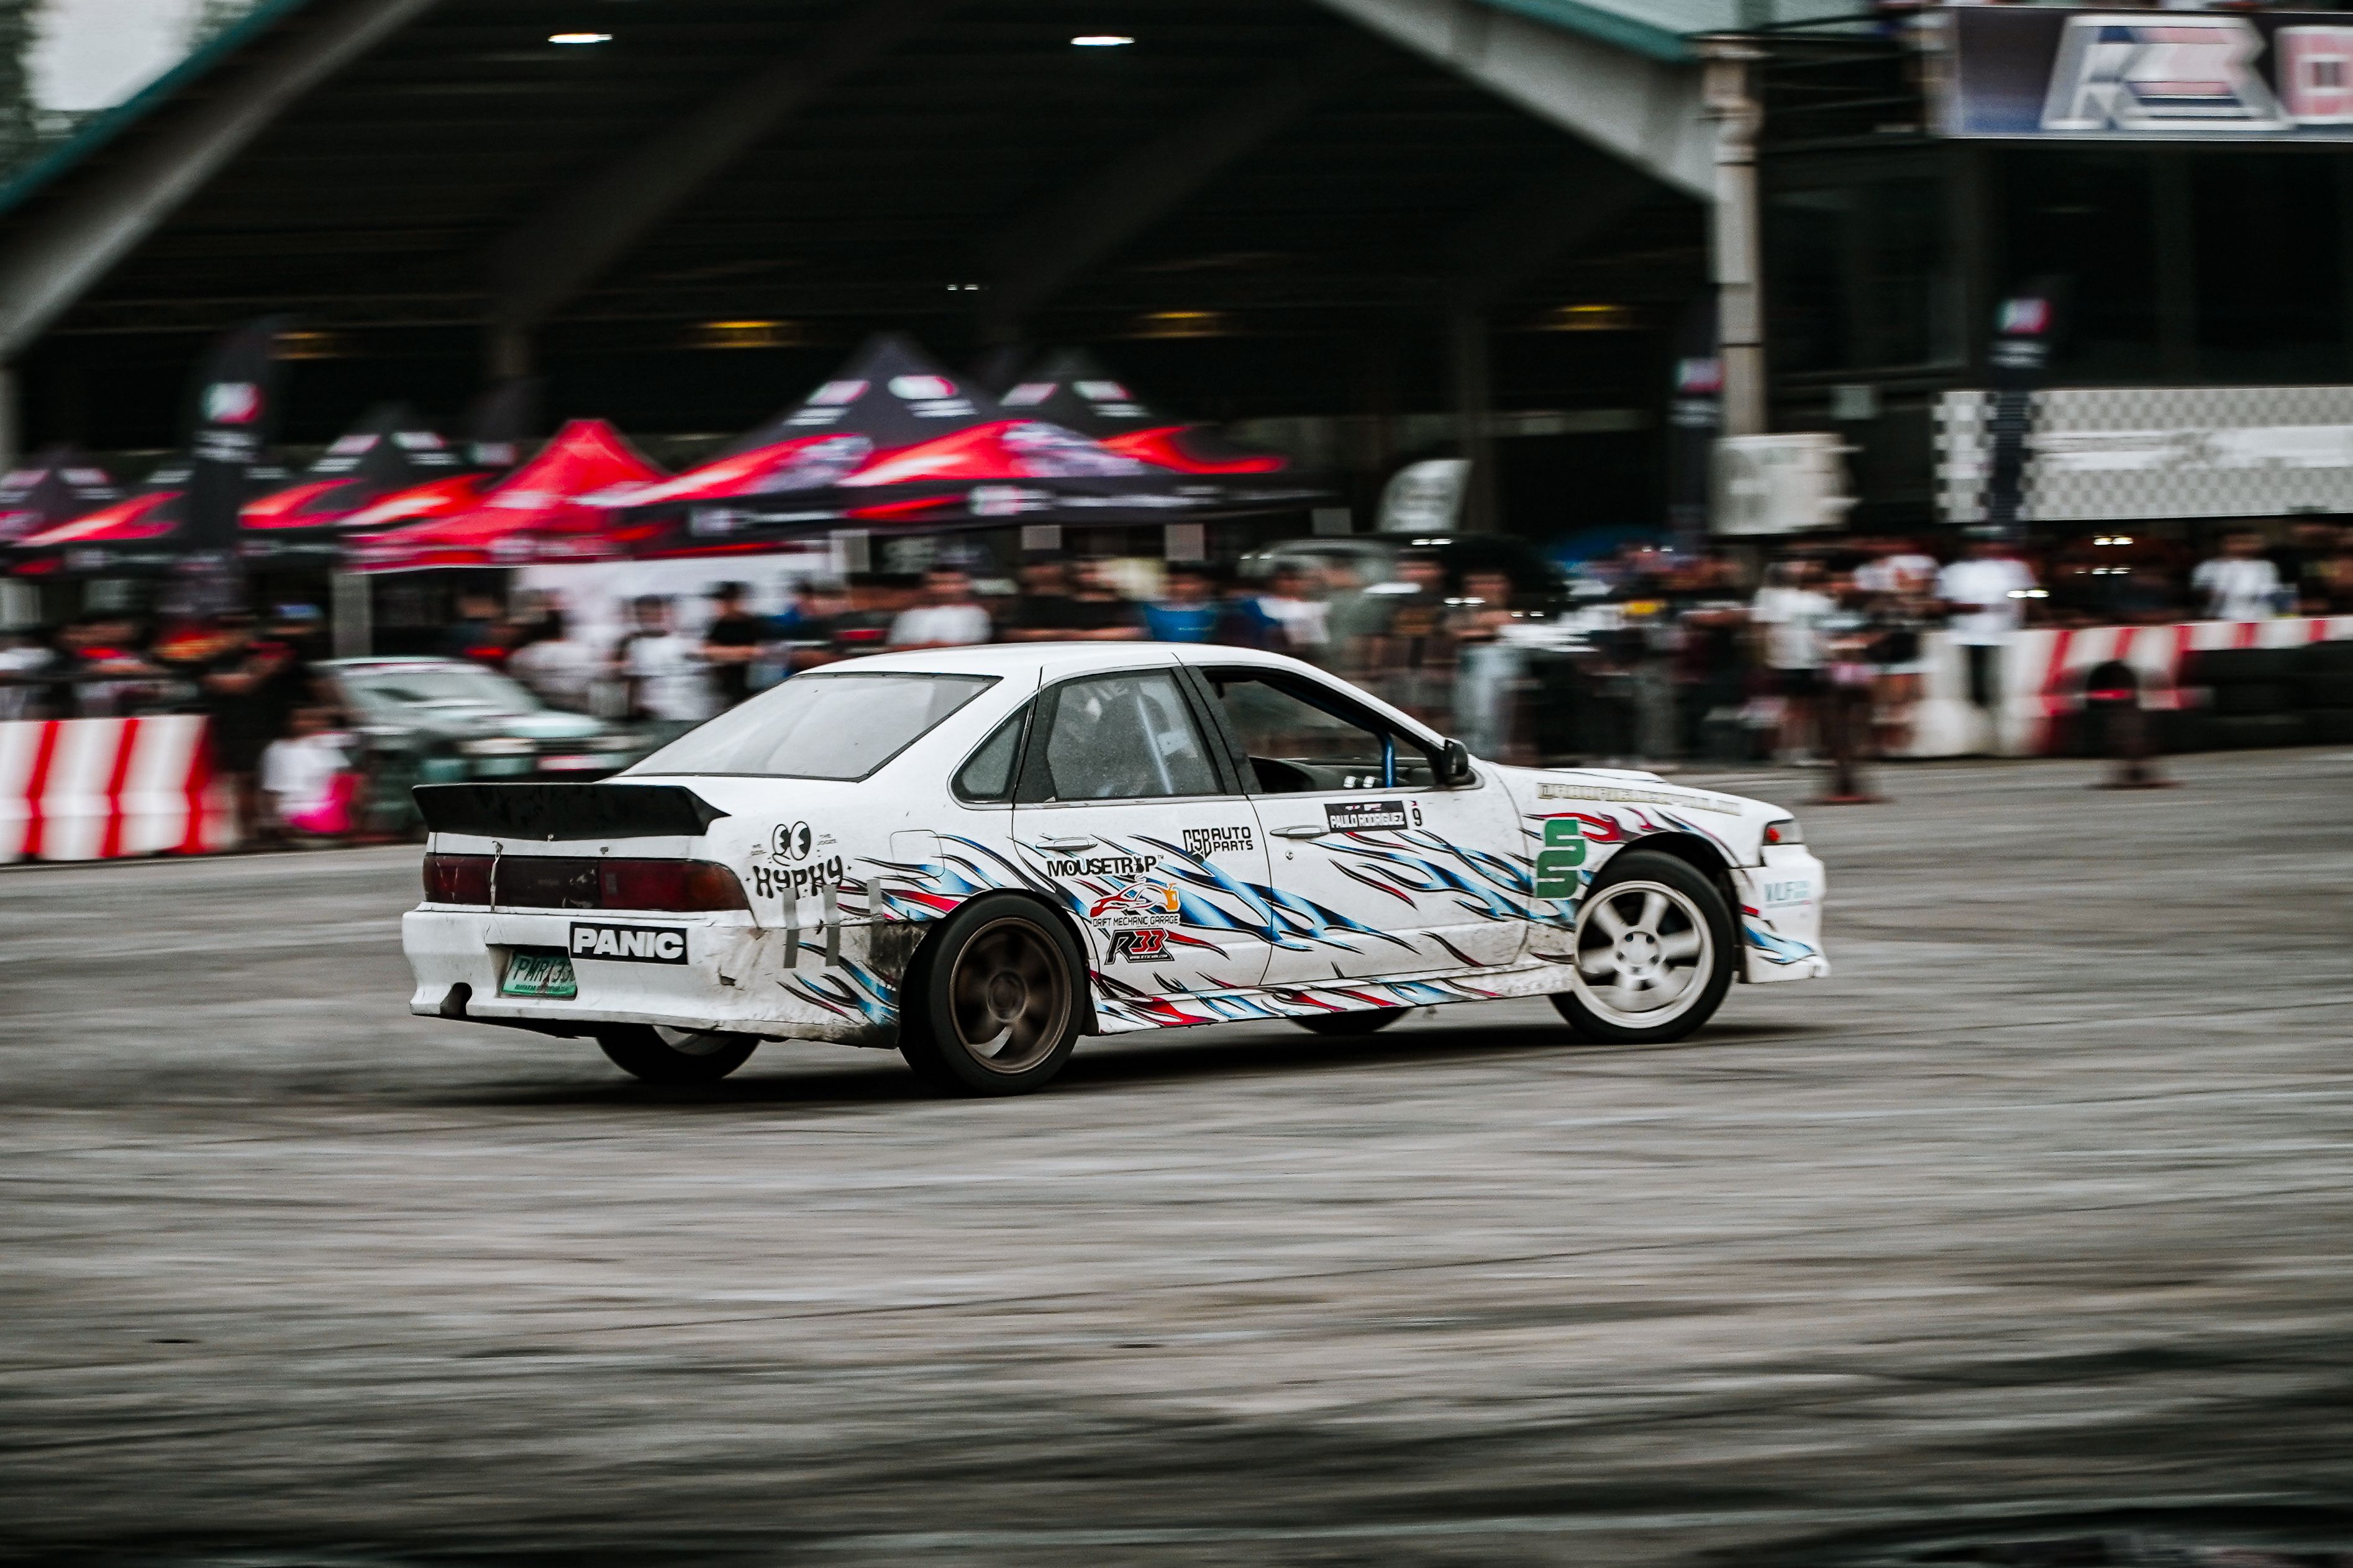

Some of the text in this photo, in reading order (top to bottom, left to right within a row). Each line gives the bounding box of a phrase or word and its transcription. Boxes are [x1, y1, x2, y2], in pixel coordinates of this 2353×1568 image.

[1412, 808, 1422, 827] 9
[1211, 827, 1251, 840] AUTO
[1213, 840, 1254, 851] PARTS
[1093, 915, 1178, 927] DRIFT MECHANIC GARAGE
[573, 927, 684, 959] PANIC
